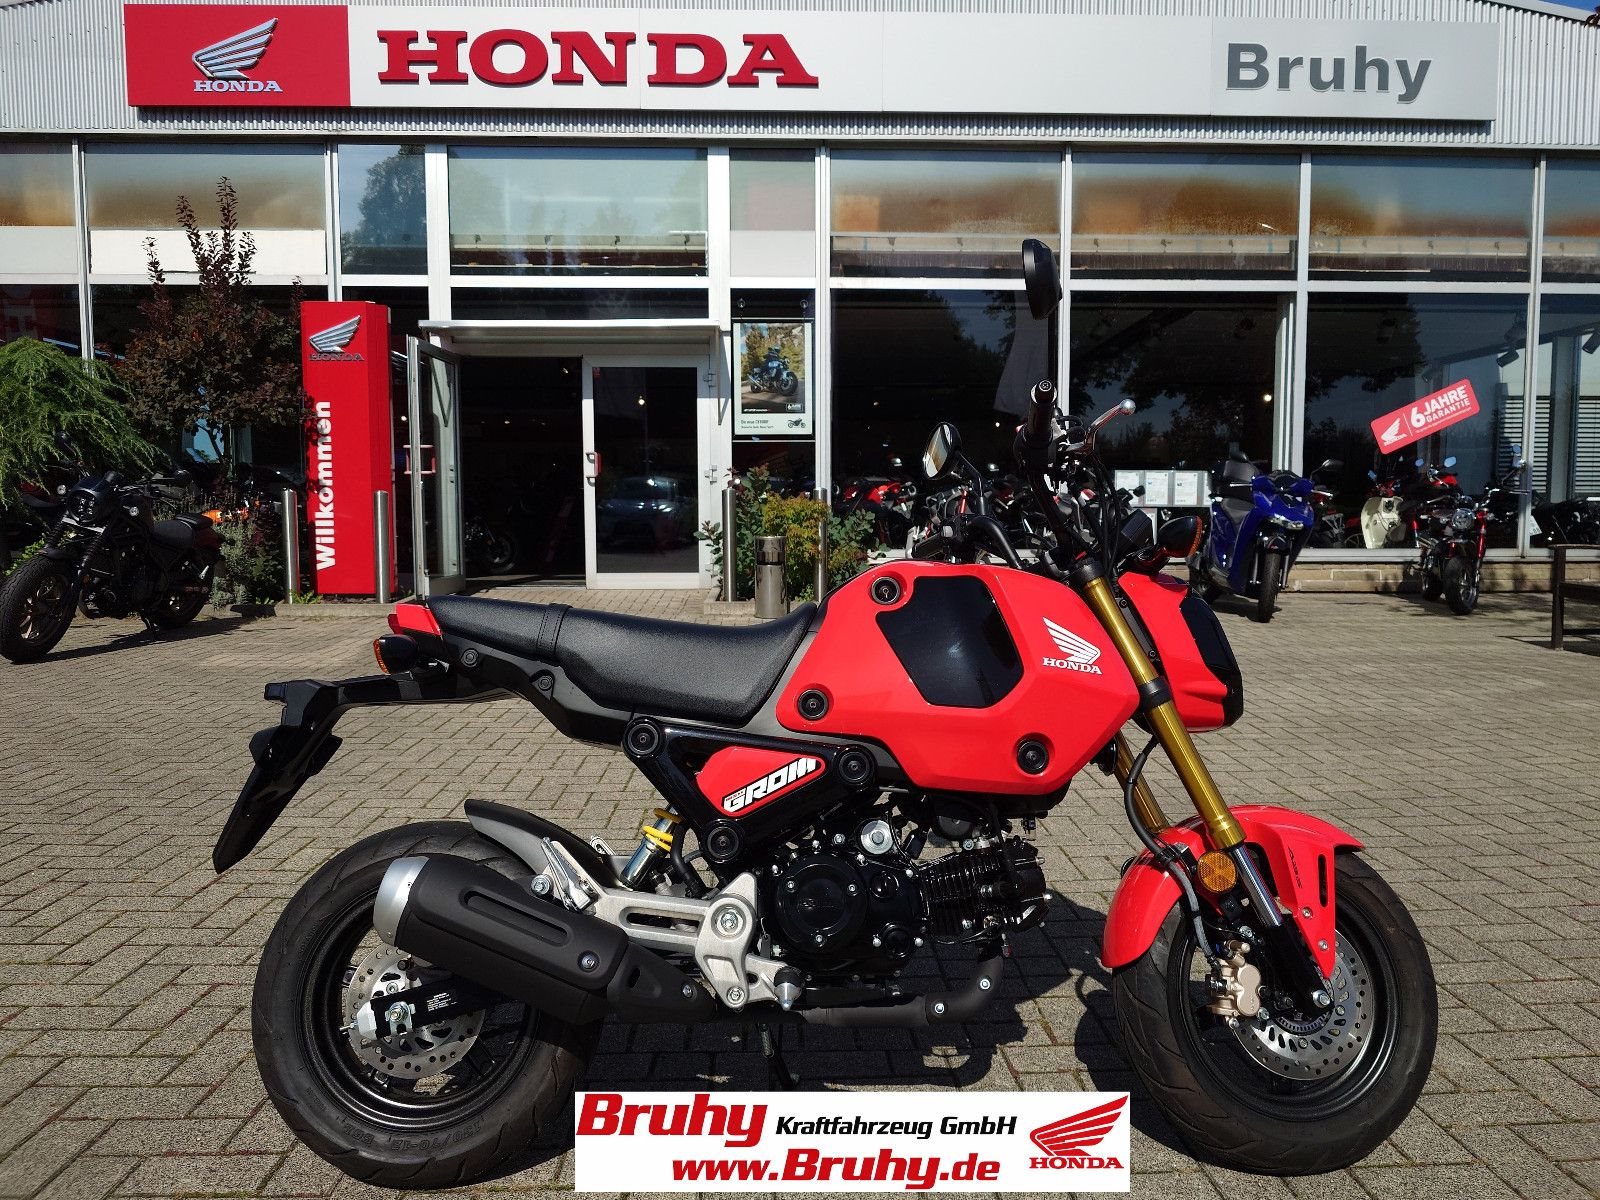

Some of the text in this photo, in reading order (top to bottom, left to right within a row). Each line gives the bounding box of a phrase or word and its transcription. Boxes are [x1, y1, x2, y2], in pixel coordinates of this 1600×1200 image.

[377, 28, 819, 87] HONDA
[1226, 43, 1432, 104] Bruhy
[193, 80, 283, 92] HONDA
[310, 353, 365, 362] HONDA
[1410, 407, 1425, 428] 6
[1424, 386, 1468, 415] JAHRE
[1425, 398, 1470, 423] GARANTIE
[315, 401, 336, 570] Willkommen
[1042, 657, 1103, 675] HONDA
[723, 757, 817, 813] GROM
